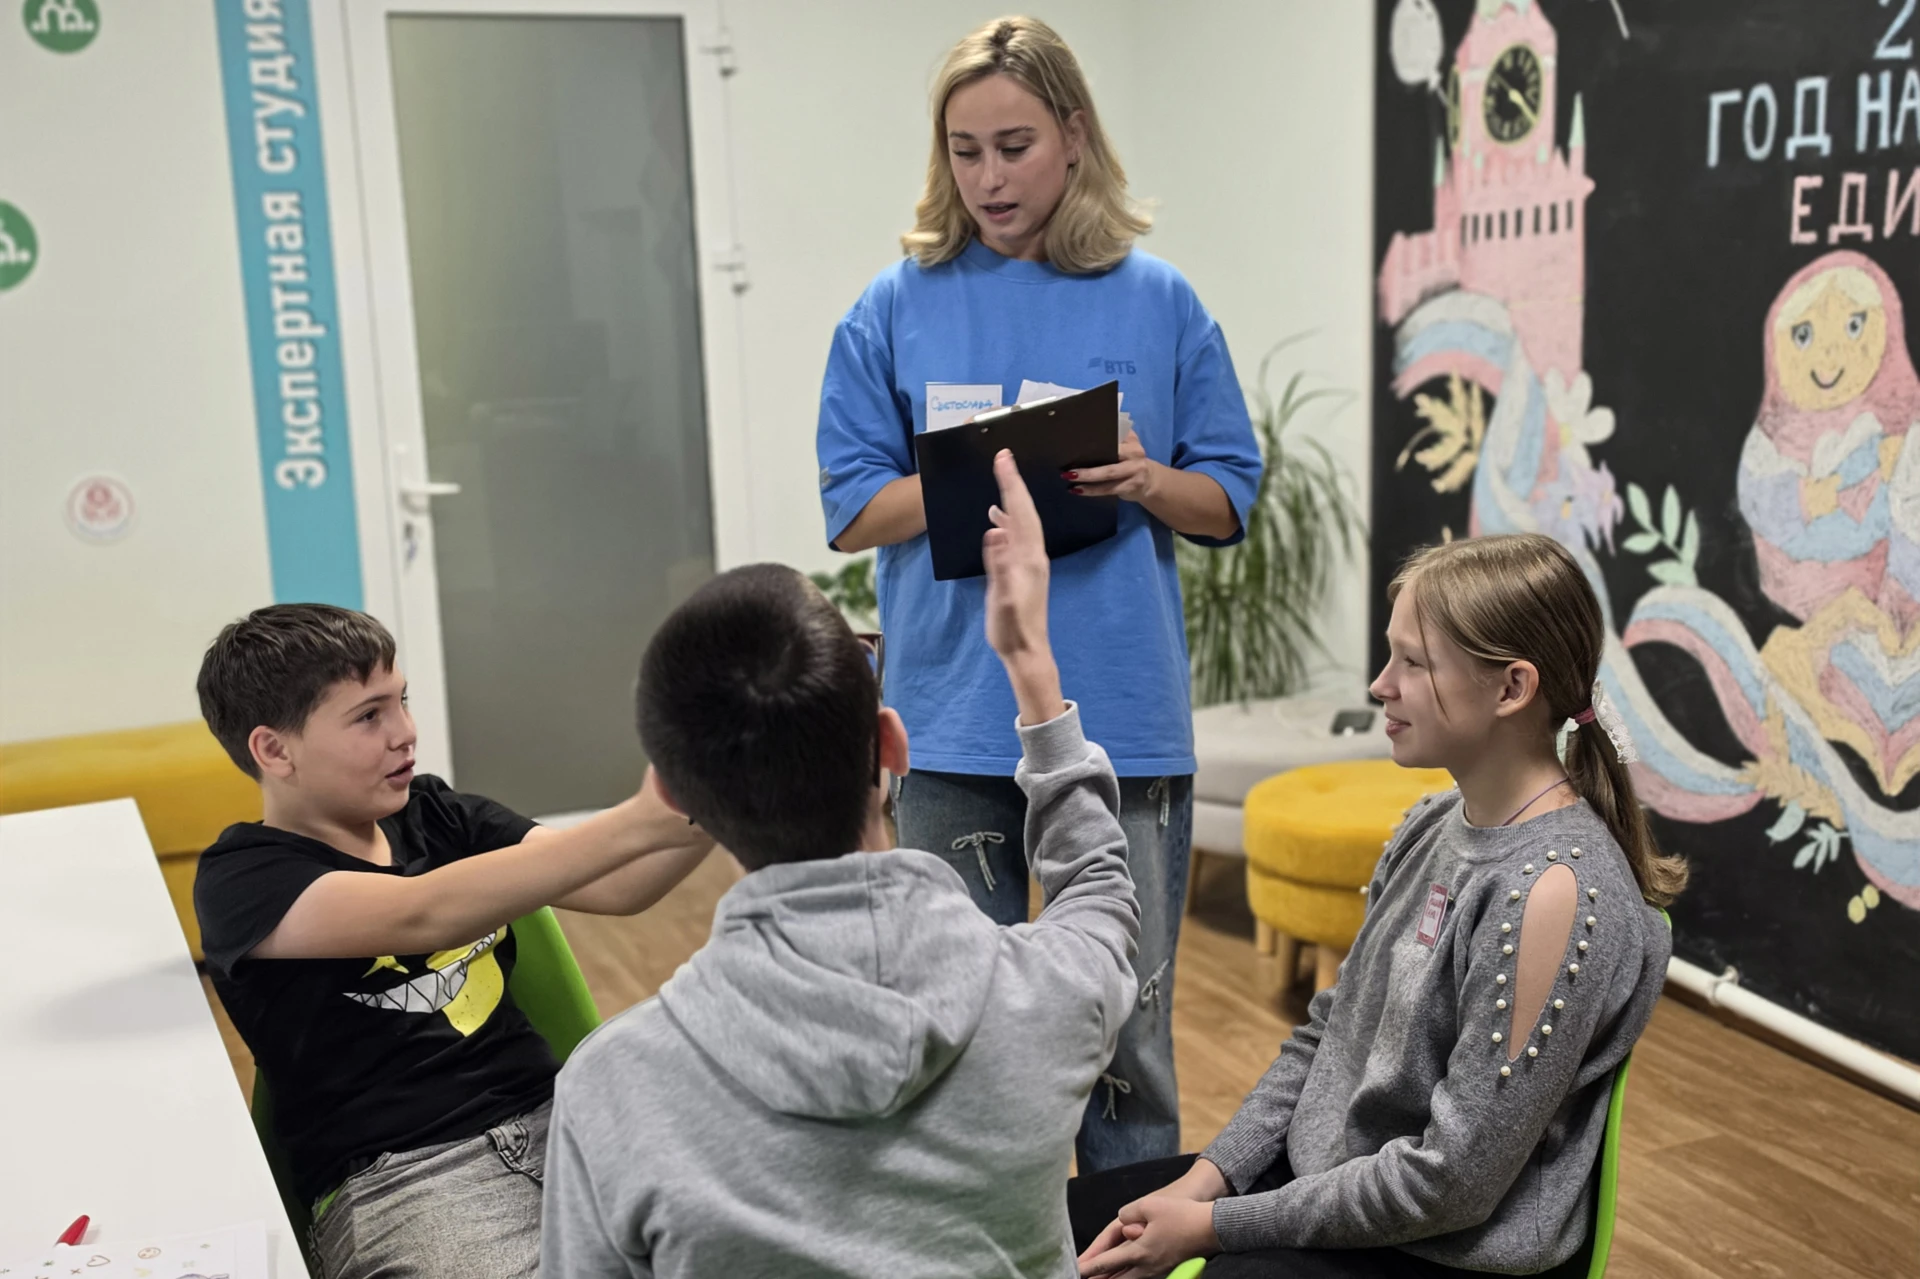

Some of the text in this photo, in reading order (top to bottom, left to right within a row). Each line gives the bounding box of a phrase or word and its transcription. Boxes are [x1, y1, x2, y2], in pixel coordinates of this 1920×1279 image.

[1707, 76, 1831, 168] ГОД
[244, 0, 327, 489] Экспертная студия
[1790, 167, 1920, 244] ЕДИ
[1104, 360, 1136, 375] ВТБ
